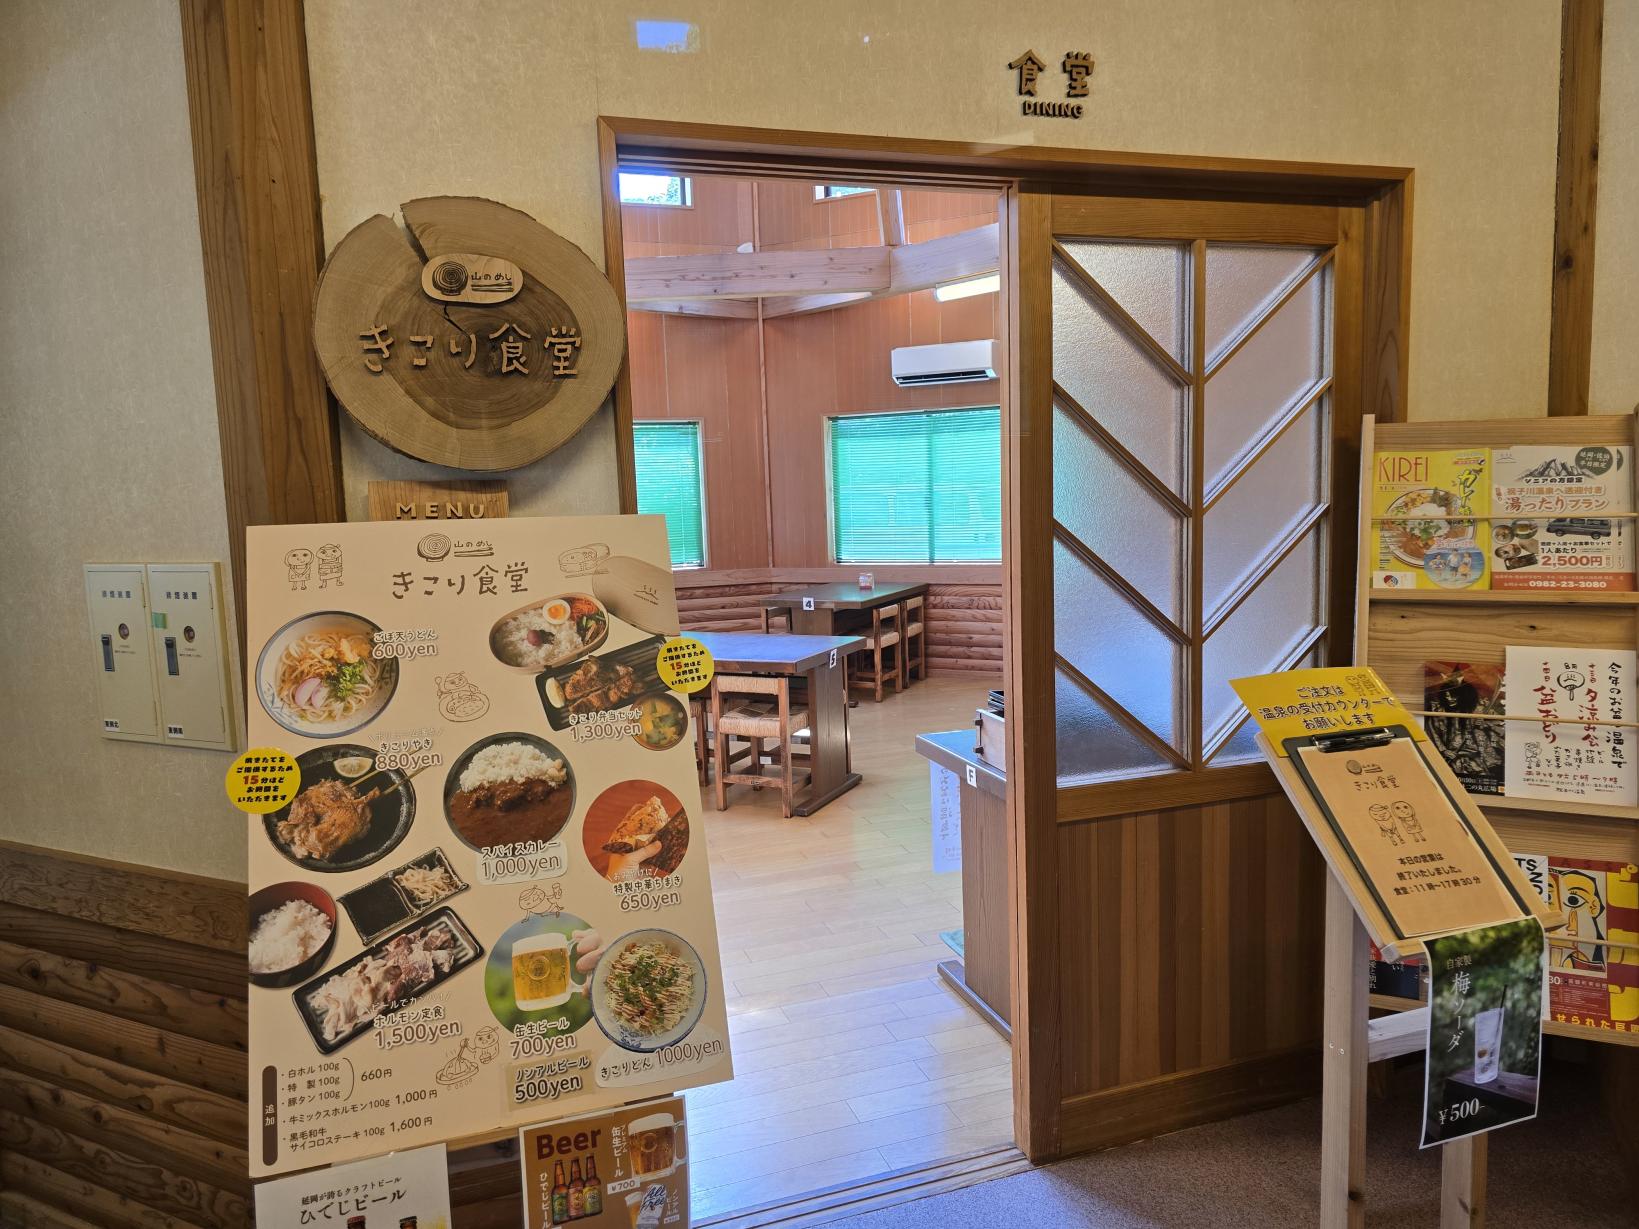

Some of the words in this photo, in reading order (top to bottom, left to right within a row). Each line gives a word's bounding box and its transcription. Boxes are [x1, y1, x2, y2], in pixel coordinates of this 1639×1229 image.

[1007, 49, 1095, 98] 食堂
[1022, 100, 1084, 119] DINING
[471, 271, 512, 282] 山のめし
[359, 323, 582, 378] きこり食堂
[1379, 457, 1429, 482] KIREI
[396, 503, 486, 519] MENU
[1505, 496, 1607, 511] 湯ったりプラン
[454, 540, 494, 548] 山のめし
[1541, 555, 1602, 568] 2,500円
[392, 561, 529, 600] きこり食堂
[805, 600, 812, 609] 4
[373, 629, 437, 643] ごぼ天うどん
[372, 642, 437, 661] 600yen
[1297, 685, 1344, 698] ご注文は
[569, 710, 642, 726] きこり弁当セット
[1258, 696, 1395, 720] 温泉の受付カウンターで
[1533, 685, 1559, 744] 盆おどり
[1302, 712, 1375, 731] お願いします
[569, 722, 642, 742] 1,300yen
[379, 738, 432, 753] きこりやき
[376, 752, 442, 772] 880yen
[967, 769, 974, 783] F
[1353, 775, 1400, 791] きこり食堂
[481, 839, 560, 859] スパイスカレー
[481, 854, 561, 879] 1,000yen
[1396, 853, 1445, 866] 本日の営業は
[613, 875, 681, 895] 特製中華ちまき
[620, 892, 680, 912] 650yen
[1446, 955, 1472, 969] 自家製
[373, 1004, 444, 1028] ホルモン定食
[1447, 970, 1472, 1053] 梅ソーダ
[374, 1020, 461, 1049] 1,500yen
[514, 1016, 570, 1039] 缶生ビール
[510, 1033, 577, 1058] 700yen
[657, 1038, 722, 1065] 1000yen
[288, 1066, 315, 1079] 白ホル
[318, 1062, 340, 1074] 100g
[361, 1068, 392, 1082] 660円
[515, 1055, 591, 1082] ノンアルビール
[600, 1059, 653, 1080] きこりどん
[319, 1076, 340, 1088] 100g
[515, 1075, 582, 1103] 500yen
[319, 1090, 341, 1102] 100g
[265, 1104, 275, 1126] 追加
[289, 1128, 327, 1143] 黒毛和牛
[290, 1130, 361, 1152] サイコロステーキ
[364, 1126, 386, 1138] 100g
[536, 1128, 602, 1161] Beer
[611, 1126, 624, 1178] 缶生ビール
[611, 1180, 636, 1192] ¥700
[300, 1190, 407, 1225] ひでじビール
